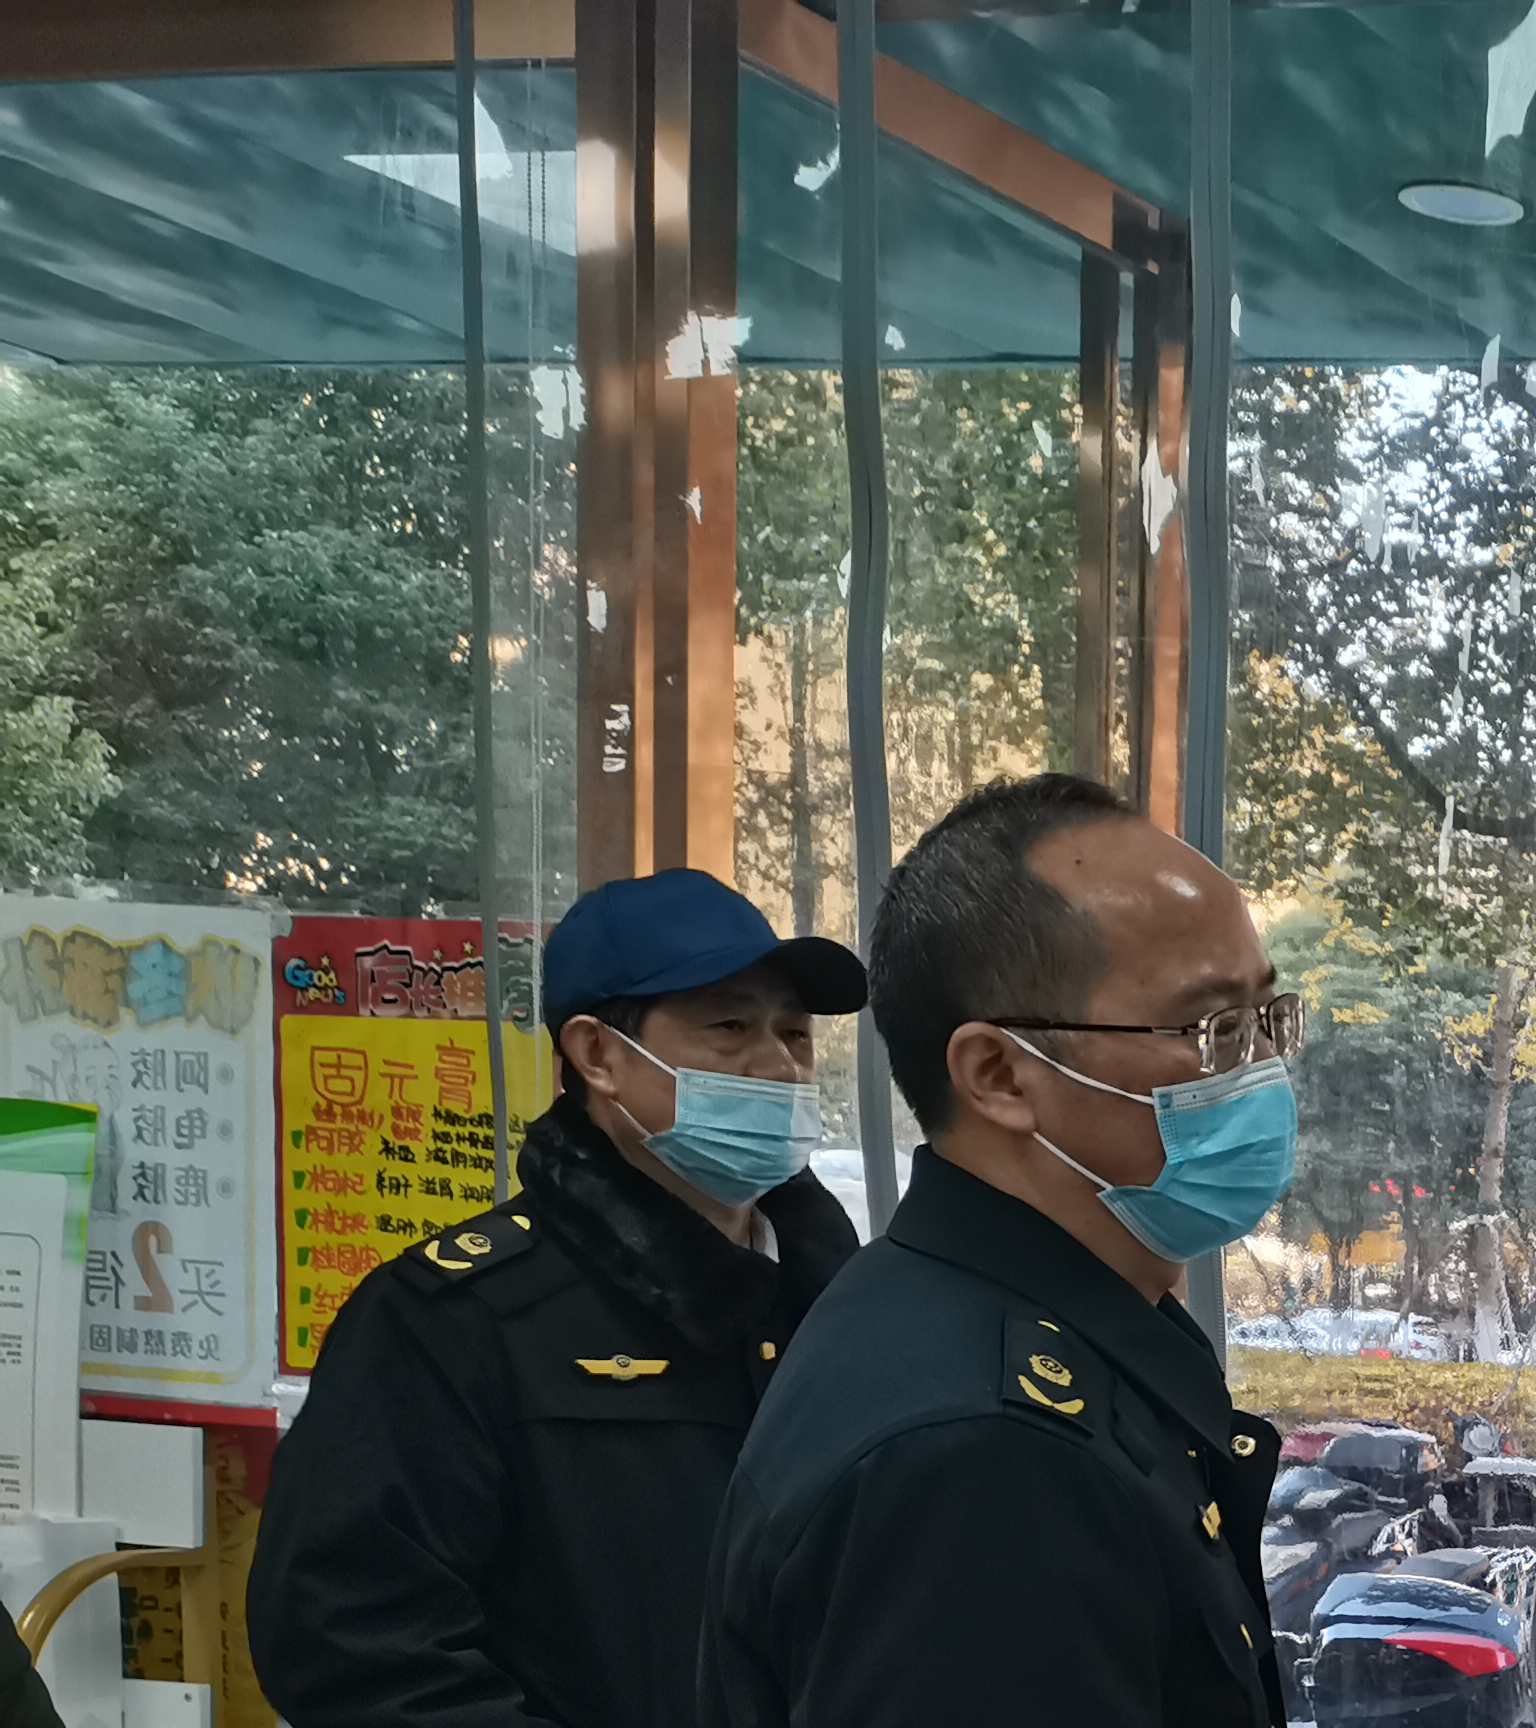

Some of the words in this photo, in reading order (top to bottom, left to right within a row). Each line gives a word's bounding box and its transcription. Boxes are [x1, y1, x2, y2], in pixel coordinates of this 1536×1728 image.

[284, 957, 338, 989] Good
[310, 1038, 478, 1115] 固元膏
